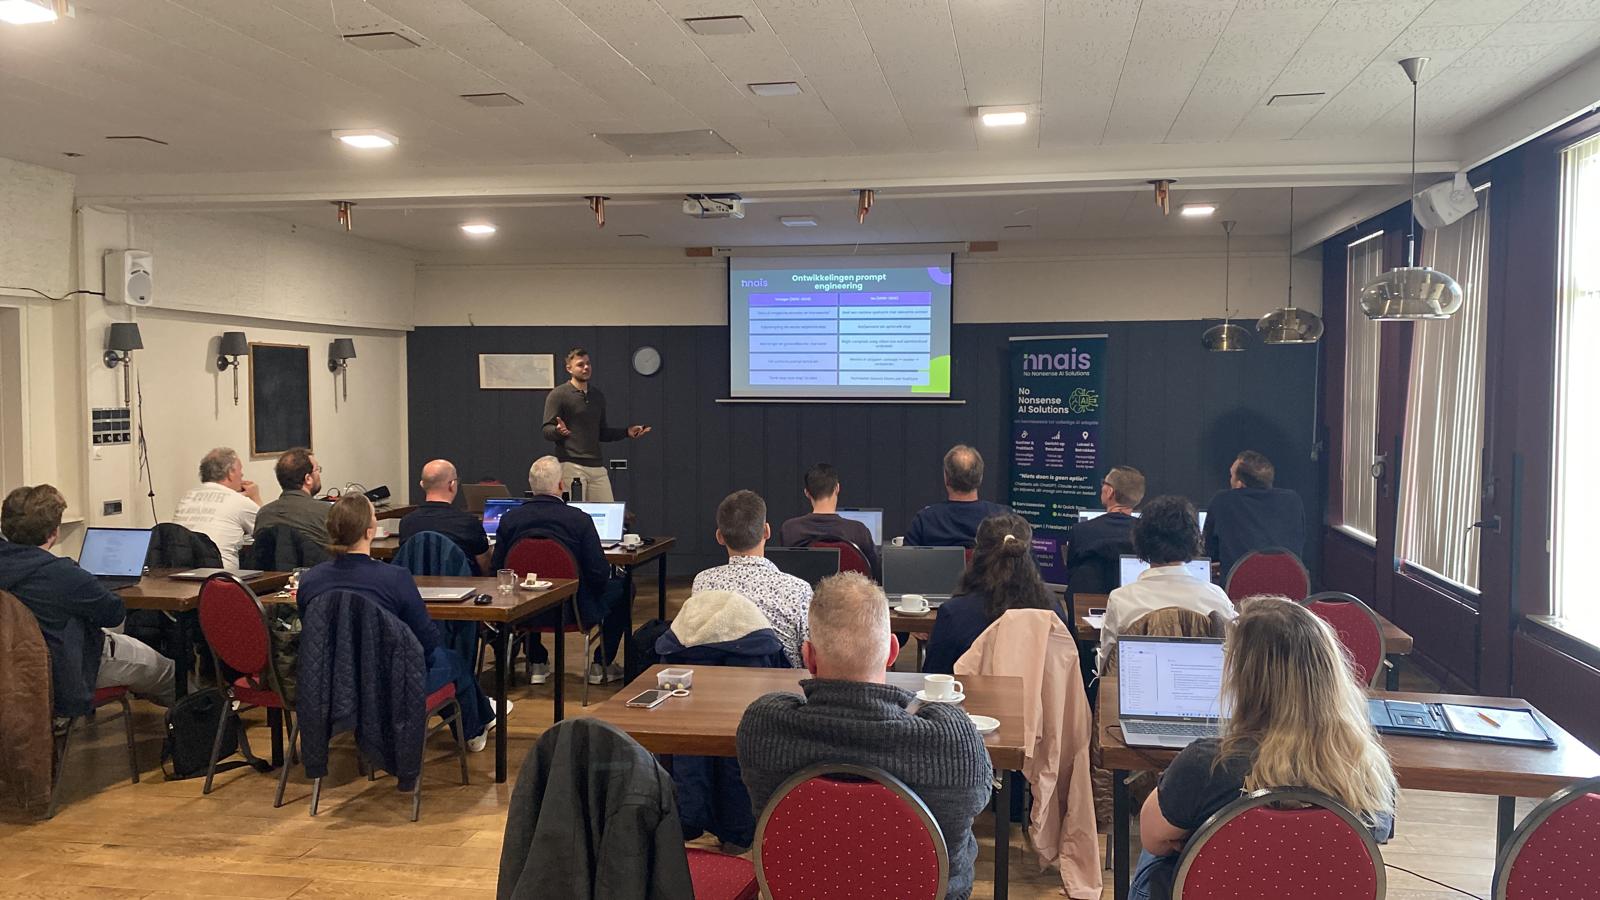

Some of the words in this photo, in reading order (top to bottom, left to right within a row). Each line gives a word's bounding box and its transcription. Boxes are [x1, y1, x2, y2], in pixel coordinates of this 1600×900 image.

[792, 274, 854, 283] Ontwikkelingen
[814, 282, 862, 290] engineering
[1018, 396, 1062, 404] Nonsense
